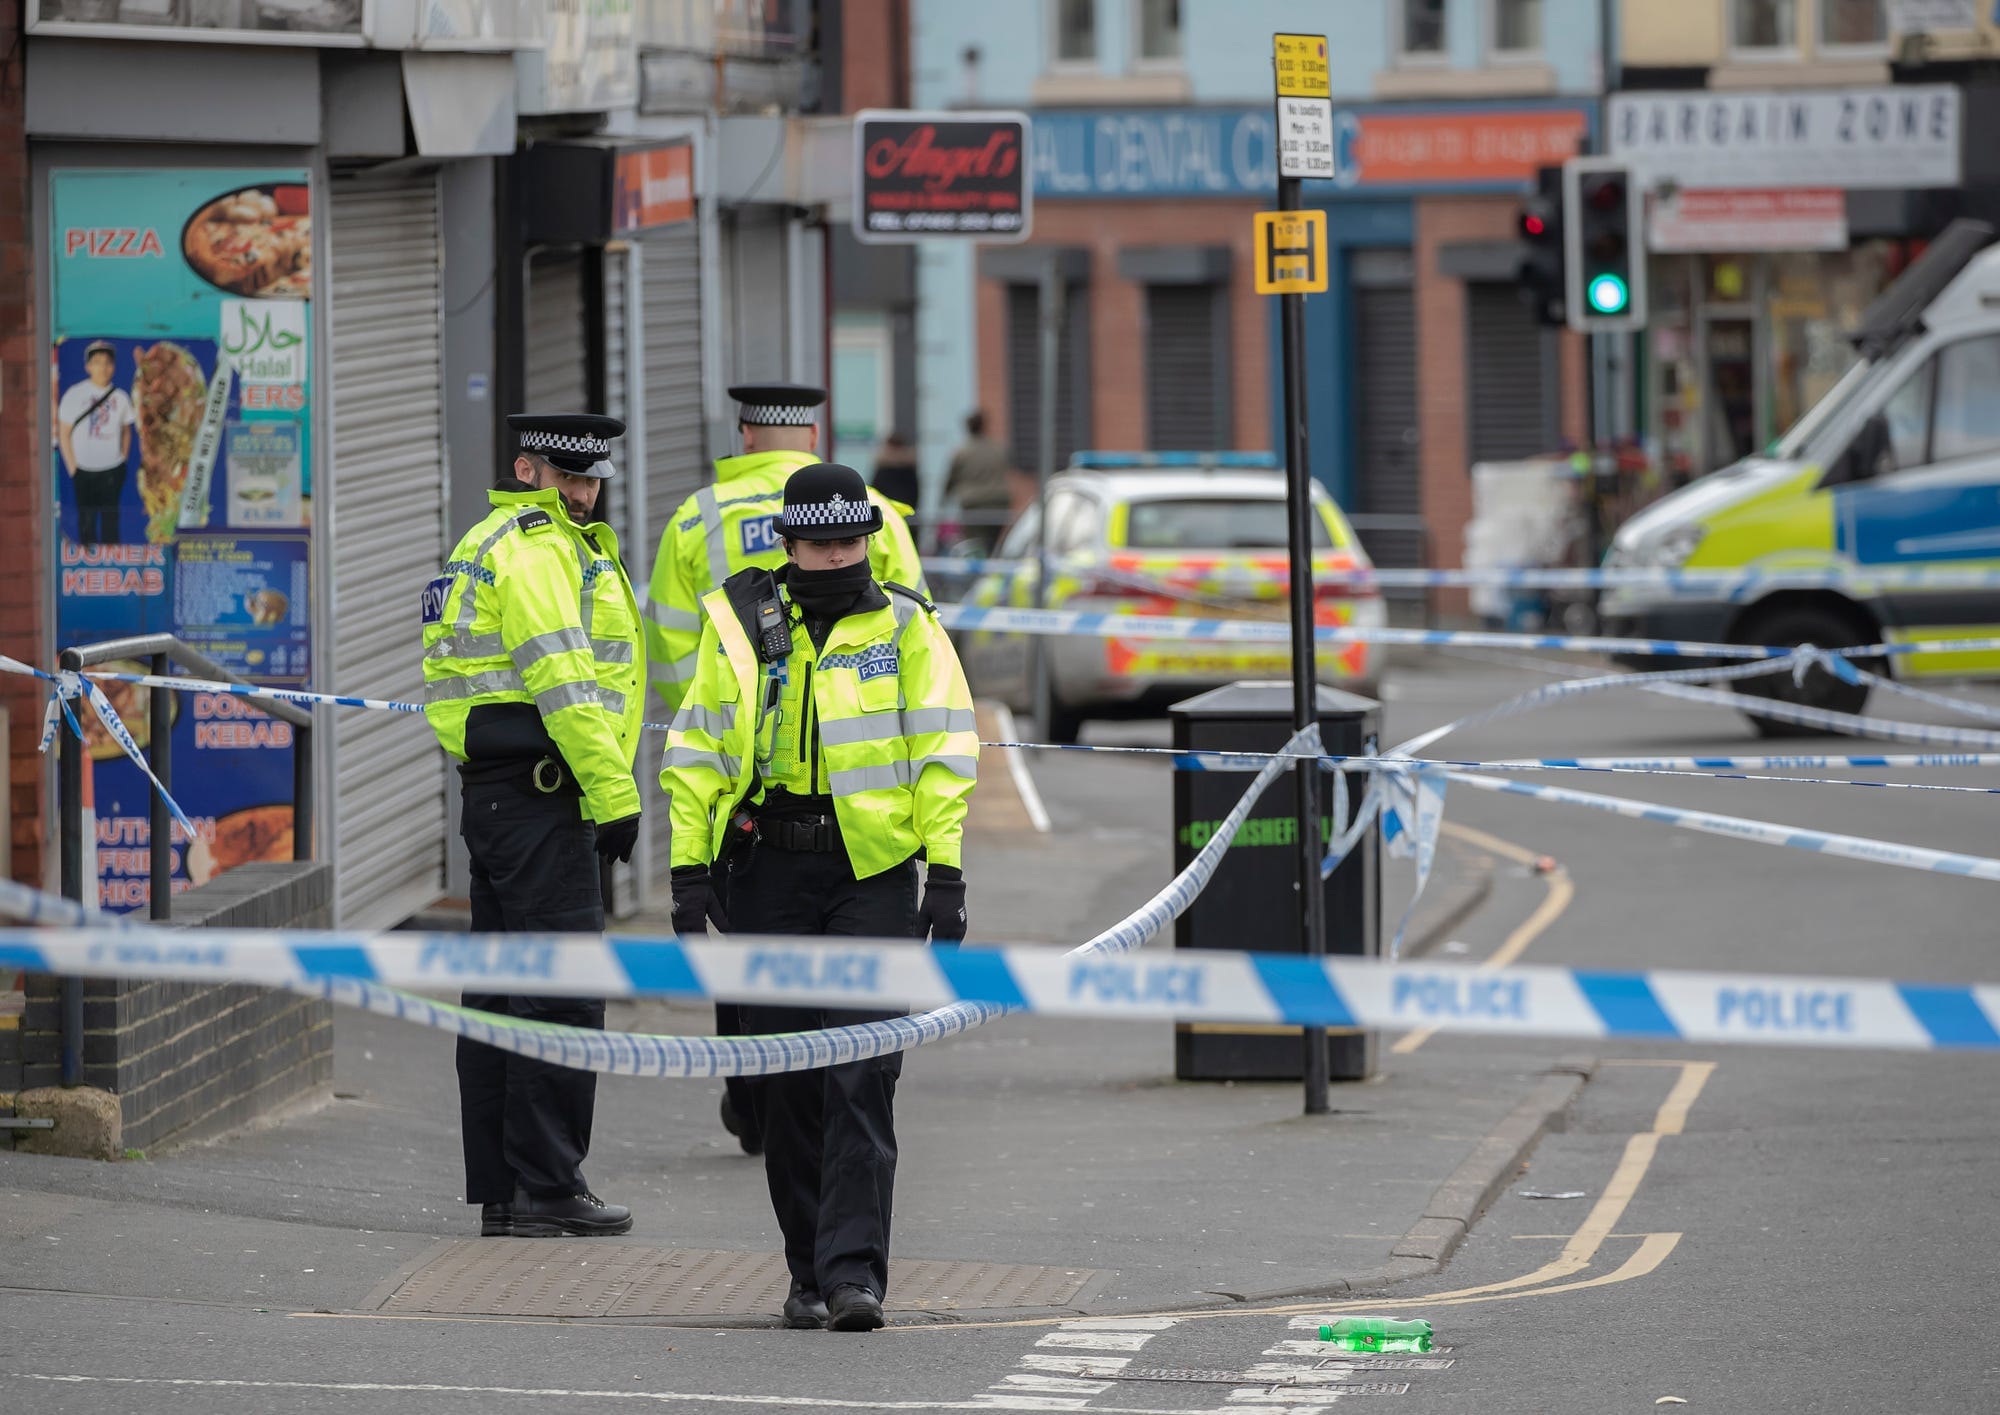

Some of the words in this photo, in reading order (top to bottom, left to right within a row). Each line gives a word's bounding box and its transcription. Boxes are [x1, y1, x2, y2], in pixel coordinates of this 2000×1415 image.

[1620, 102, 1809, 146] BARGAIN
[1837, 96, 1952, 143] ZONE
[1094, 116, 1227, 190] DENTAL
[65, 228, 164, 258] PIZZA
[60, 541, 166, 567] DONER
[62, 567, 165, 597] KEBAB
[861, 659, 898, 679] POLICE
[195, 720, 293, 749] KEBAB
[418, 934, 557, 978] POLICE
[745, 945, 882, 991] POLICE
[1069, 961, 1207, 1007] POLICE
[1391, 975, 1531, 1020] POLICE
[1716, 987, 1856, 1031] POLICE
